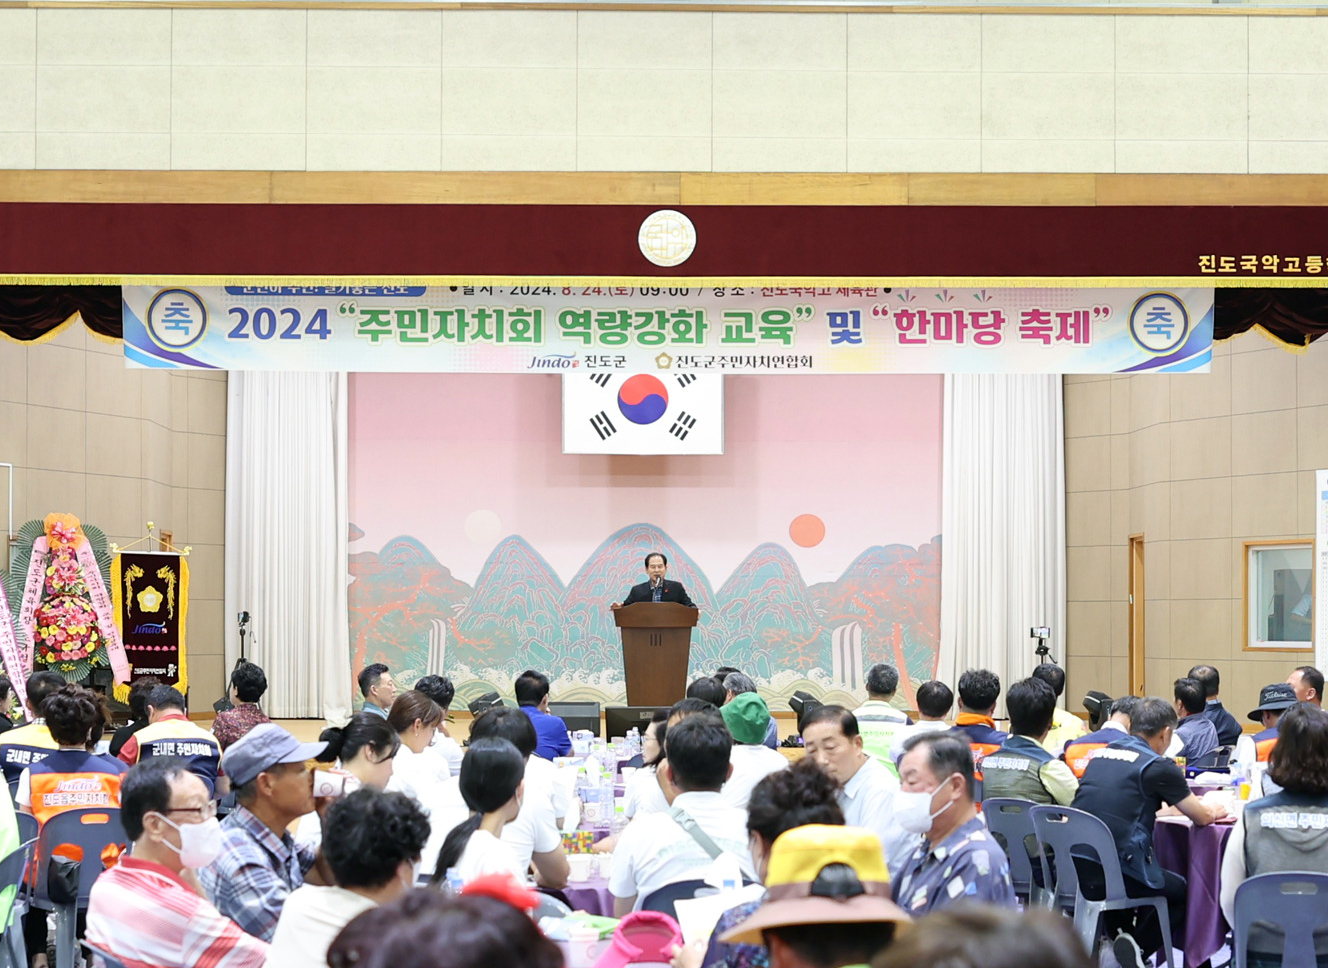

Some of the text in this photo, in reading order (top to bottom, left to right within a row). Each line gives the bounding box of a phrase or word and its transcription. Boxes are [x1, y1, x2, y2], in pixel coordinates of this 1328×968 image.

[160, 300, 195, 337] 축
[227, 307, 332, 341] 2024
[557, 307, 708, 346] 역량강화
[826, 310, 863, 345] 및
[1142, 306, 1176, 340] 축
[584, 355, 627, 369] 진도군
[675, 355, 813, 369] 진도군주민자치연합회
[5, 748, 32, 765] 군내면
[152, 742, 175, 756] 군내면
